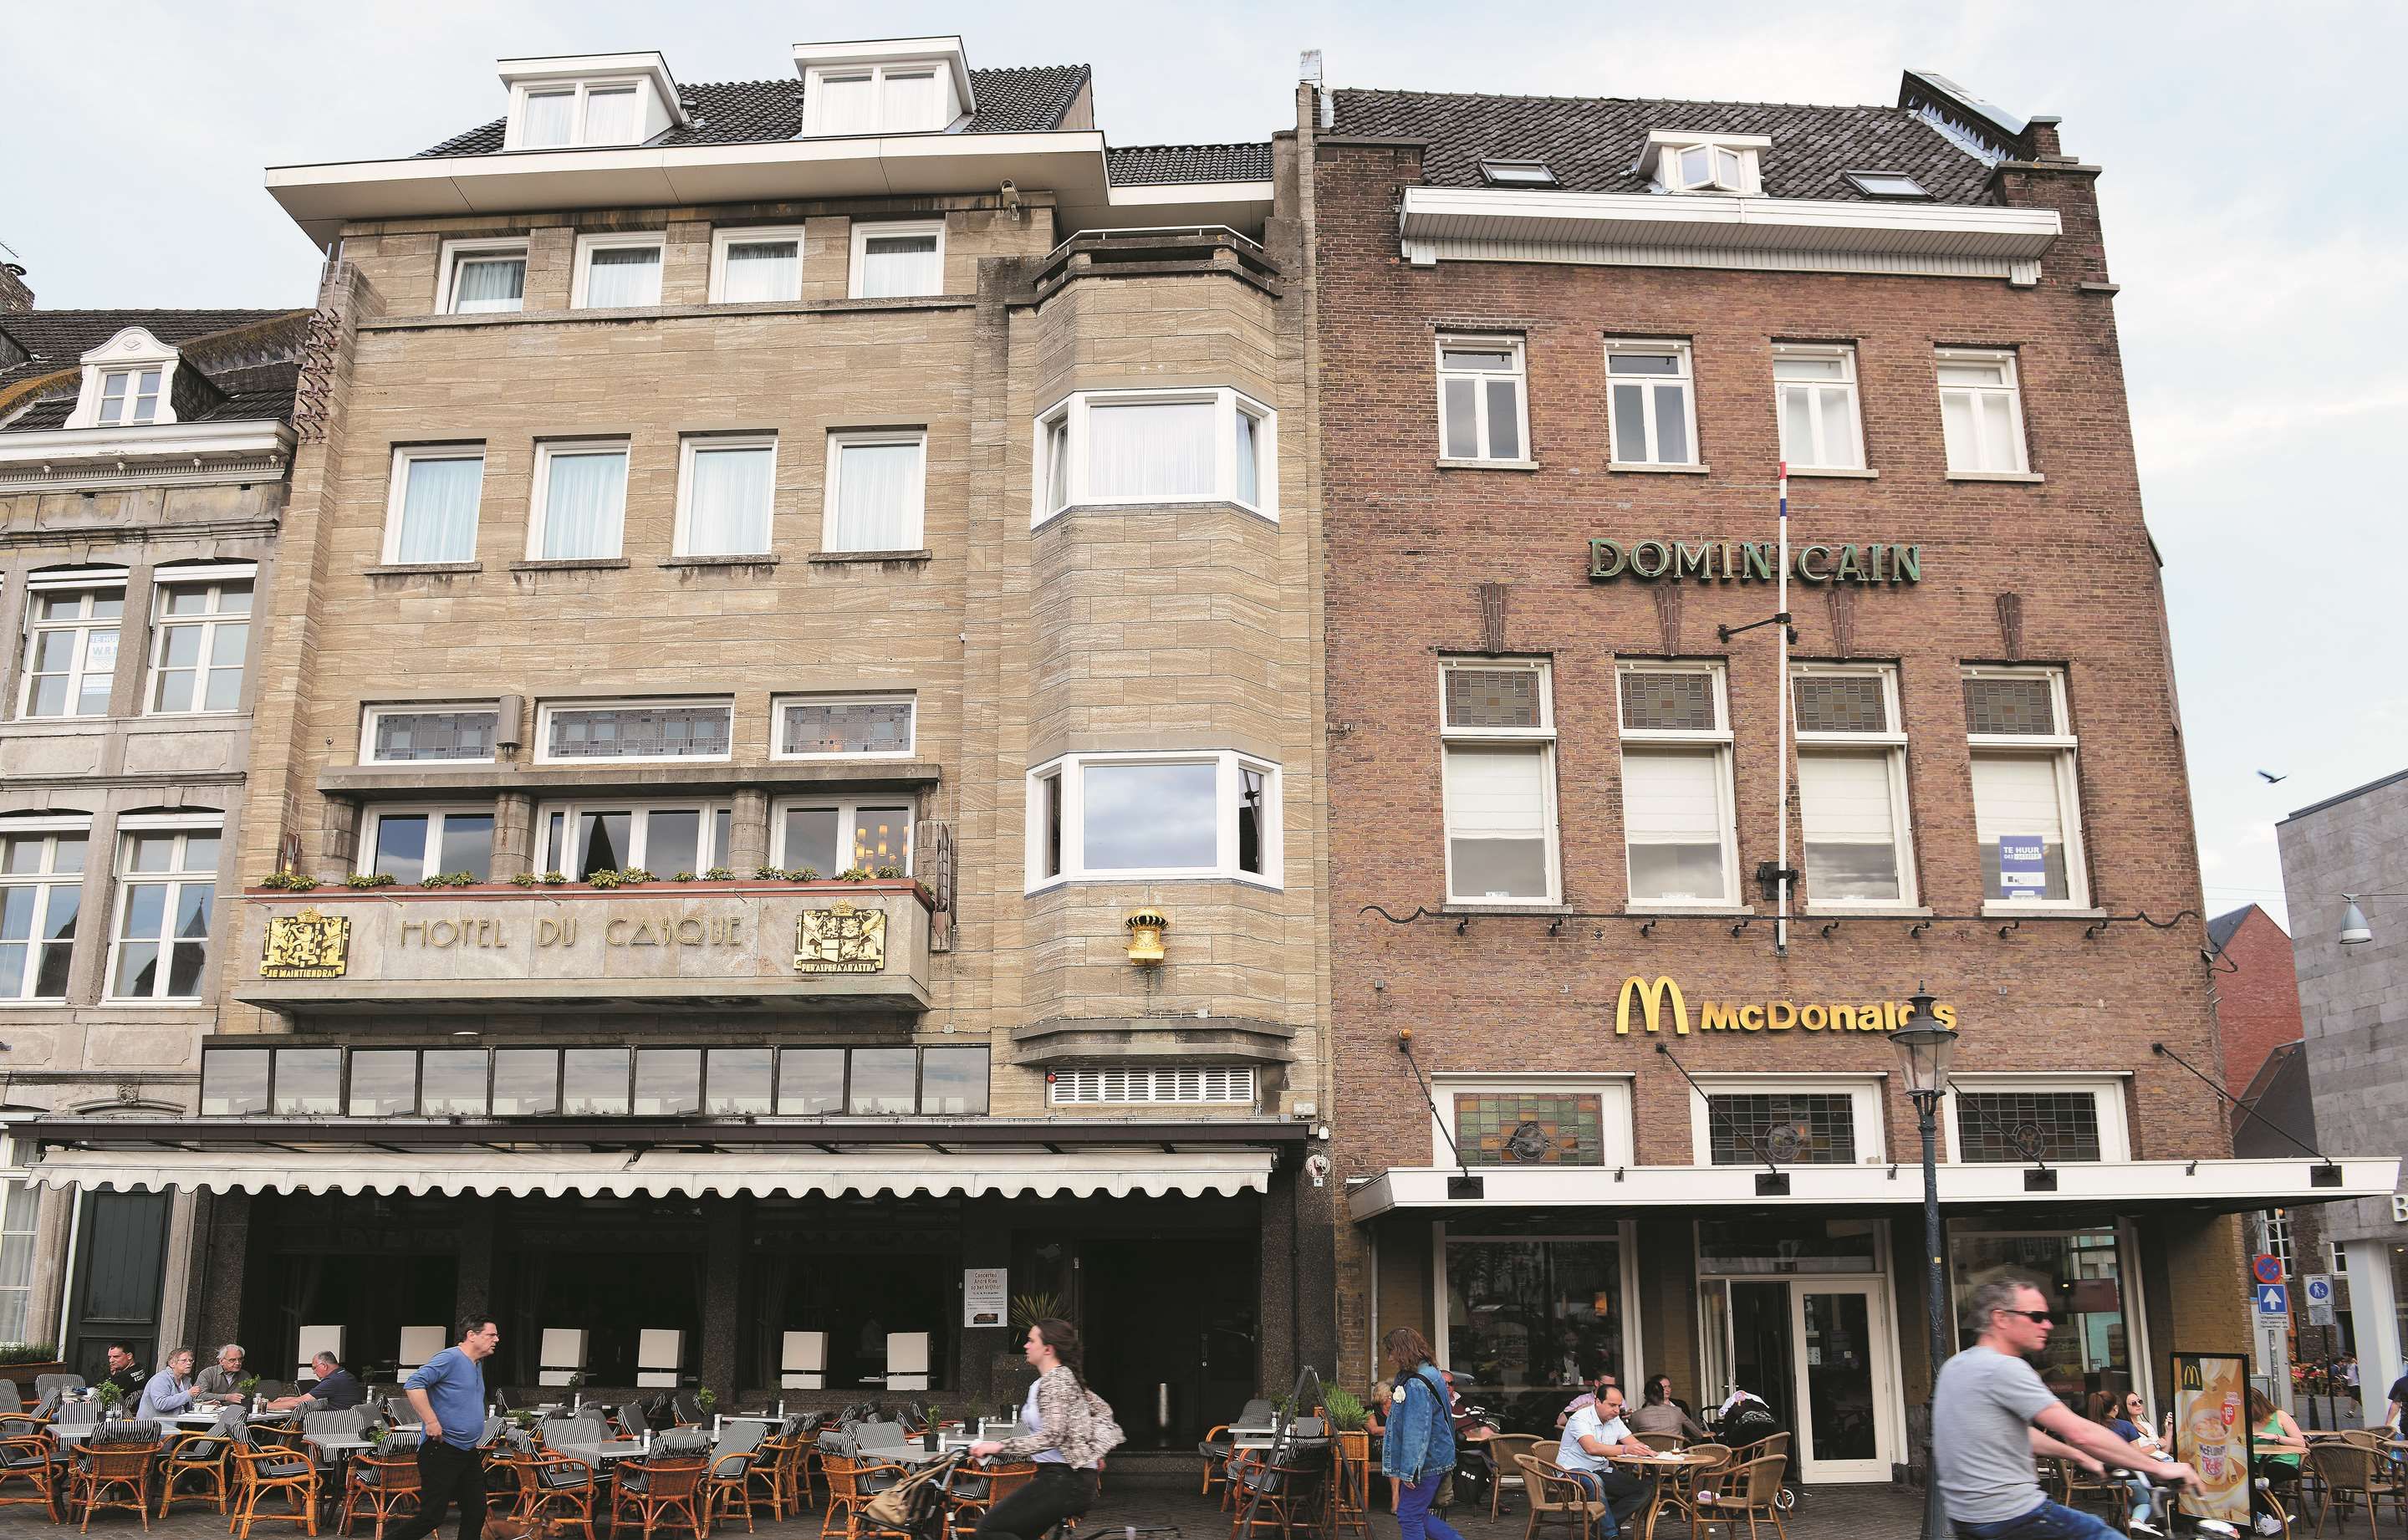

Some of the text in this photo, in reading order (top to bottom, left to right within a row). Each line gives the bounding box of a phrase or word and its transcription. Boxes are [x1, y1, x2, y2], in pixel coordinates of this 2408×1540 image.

[1589, 538, 1921, 583] DOMINICAIN
[400, 915, 742, 948] HOTEL DU CASQUE
[279, 969, 336, 978] MAINTIENDRAI
